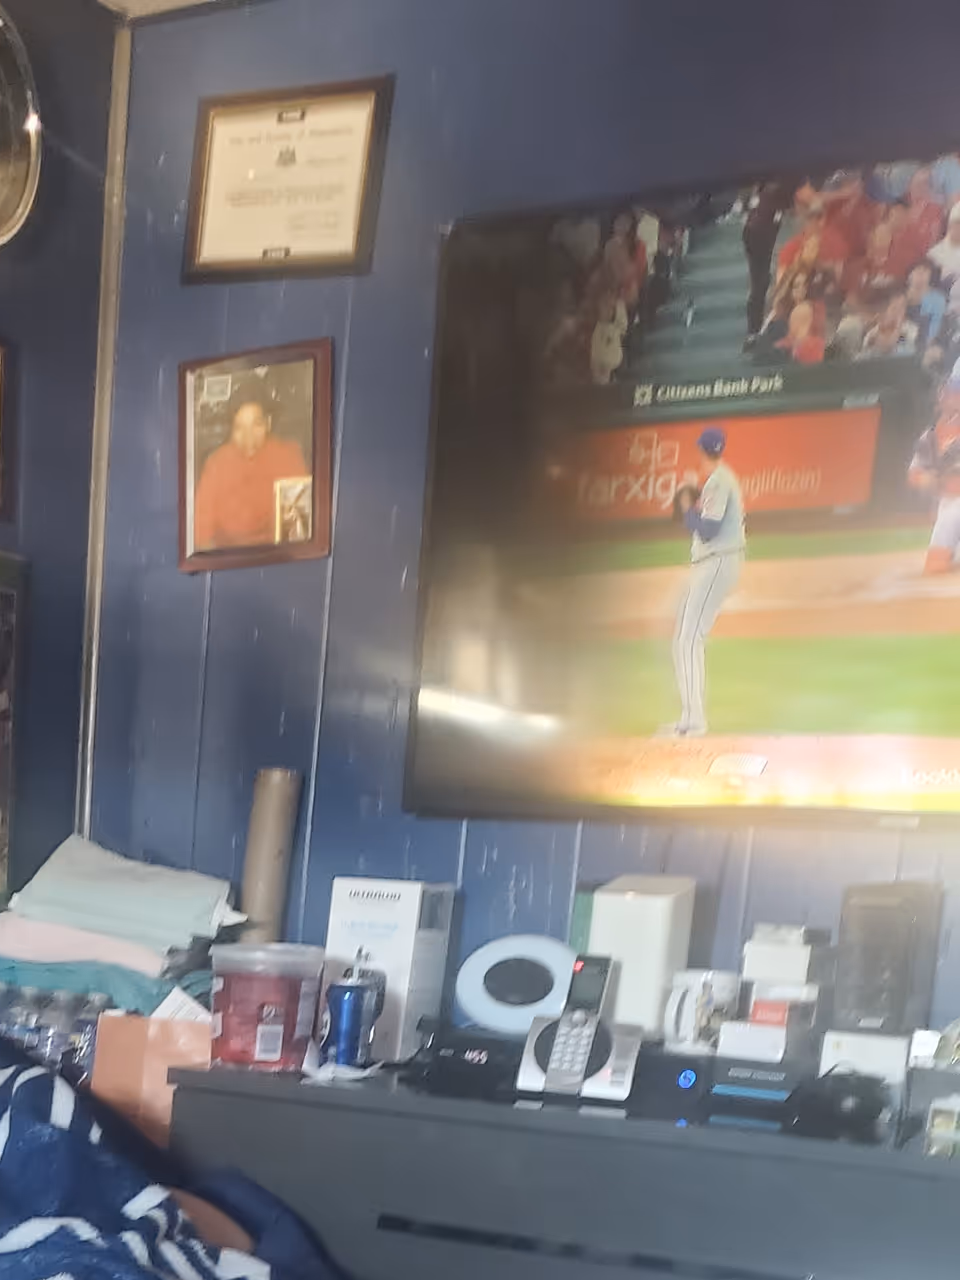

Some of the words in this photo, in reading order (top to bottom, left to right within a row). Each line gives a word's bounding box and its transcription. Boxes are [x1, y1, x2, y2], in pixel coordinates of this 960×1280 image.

[656, 383, 712, 402] Citizens
[713, 376, 749, 397] Bank
[751, 371, 784, 394] Park
